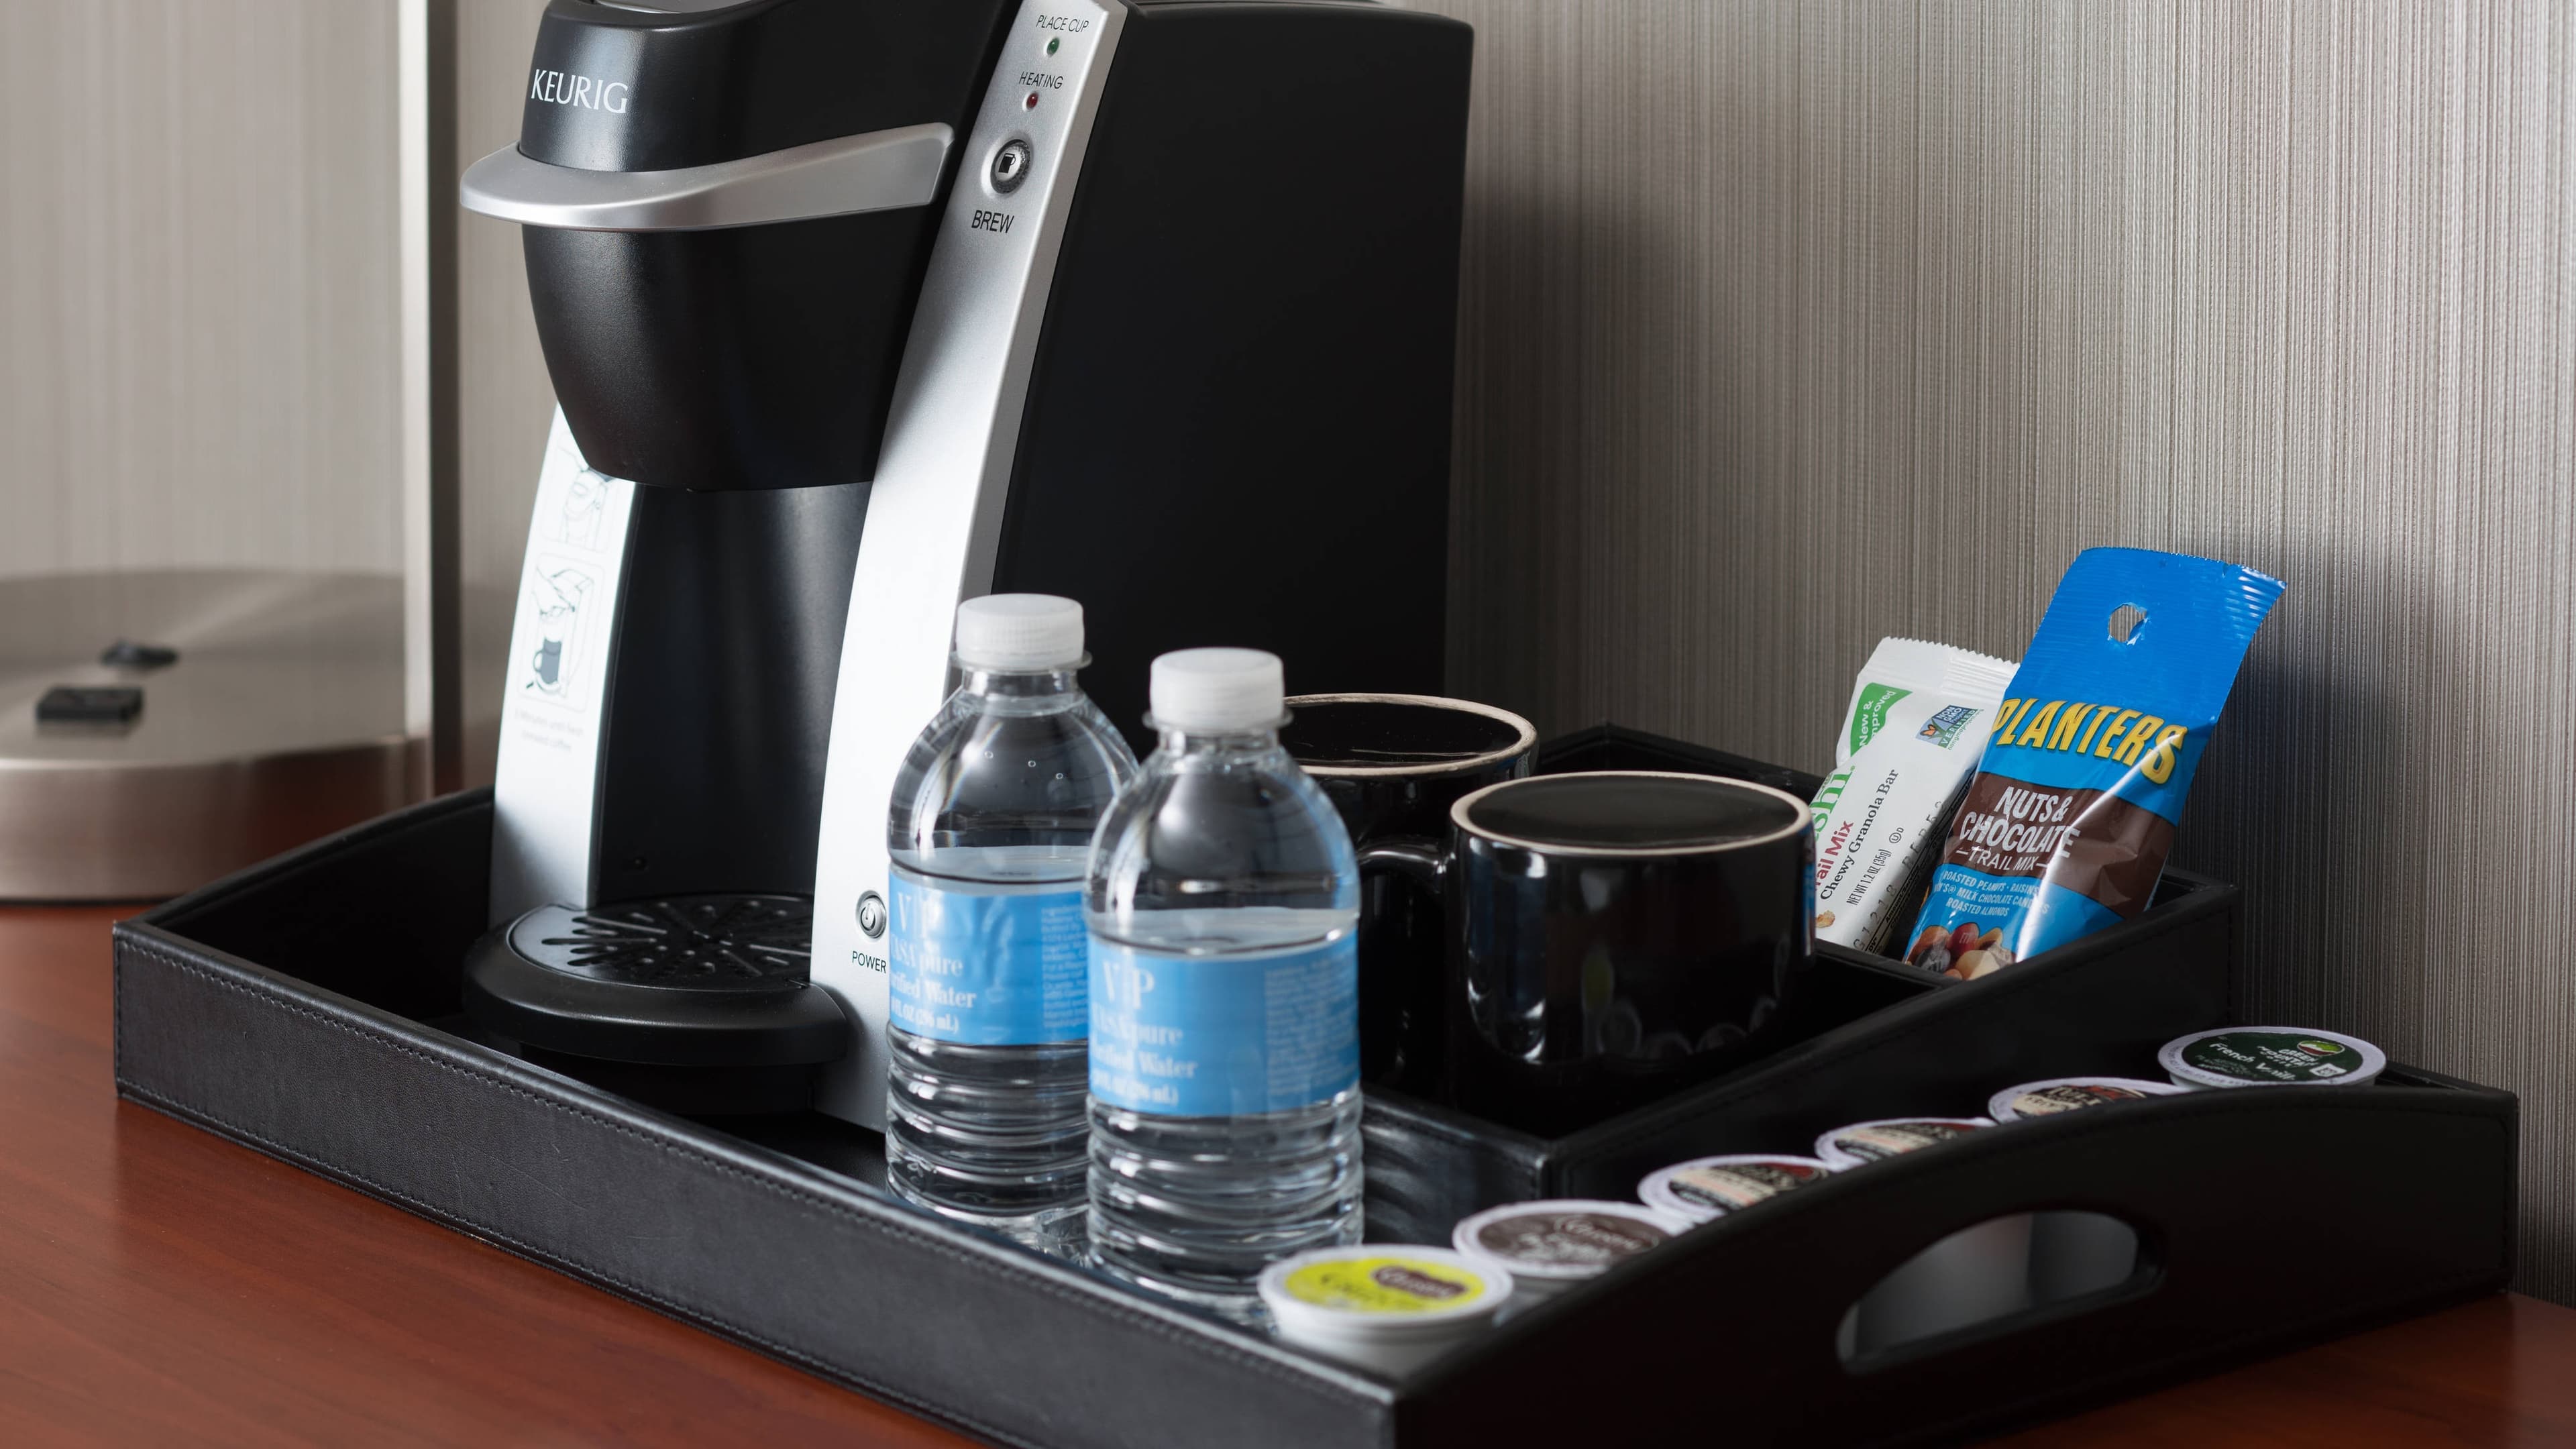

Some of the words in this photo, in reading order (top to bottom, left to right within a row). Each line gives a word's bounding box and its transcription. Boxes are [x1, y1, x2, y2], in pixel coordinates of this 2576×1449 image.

[1035, 14, 1067, 32] PLACE
[1068, 18, 1089, 33] CUP
[531, 68, 629, 114] KEURIG
[1018, 70, 1064, 90] HEATING
[971, 209, 1015, 234] BREW
[1872, 690, 1897, 735] mproved
[1943, 708, 1963, 721] GMO
[1859, 713, 1869, 747] New
[1990, 697, 2189, 786] PLANTERS
[1809, 771, 1854, 842] shi
[1993, 786, 2059, 822] NUTS
[1819, 855, 1856, 900] Chewy
[1848, 795, 1884, 854] Granola
[1876, 768, 1899, 796] Bar
[1824, 820, 1854, 857] Mix
[1959, 811, 2082, 859] CHOCOLATE
[1814, 857, 1835, 887] rail
[1968, 846, 2011, 871] TRAIL
[2012, 855, 2039, 871] MIX
[1942, 870, 1977, 888] ROASTED
[1846, 890, 1860, 906] NET
[1856, 881, 1869, 897] WT
[1945, 897, 1980, 915] ROASTED
[1980, 906, 2010, 917] ALMONDS
[1956, 886, 1979, 903] MILK
[1978, 893, 2014, 906] CHOCOLATE
[851, 950, 887, 974] POWER
[924, 979, 977, 1009] Water
[2208, 1042, 2257, 1064] French
